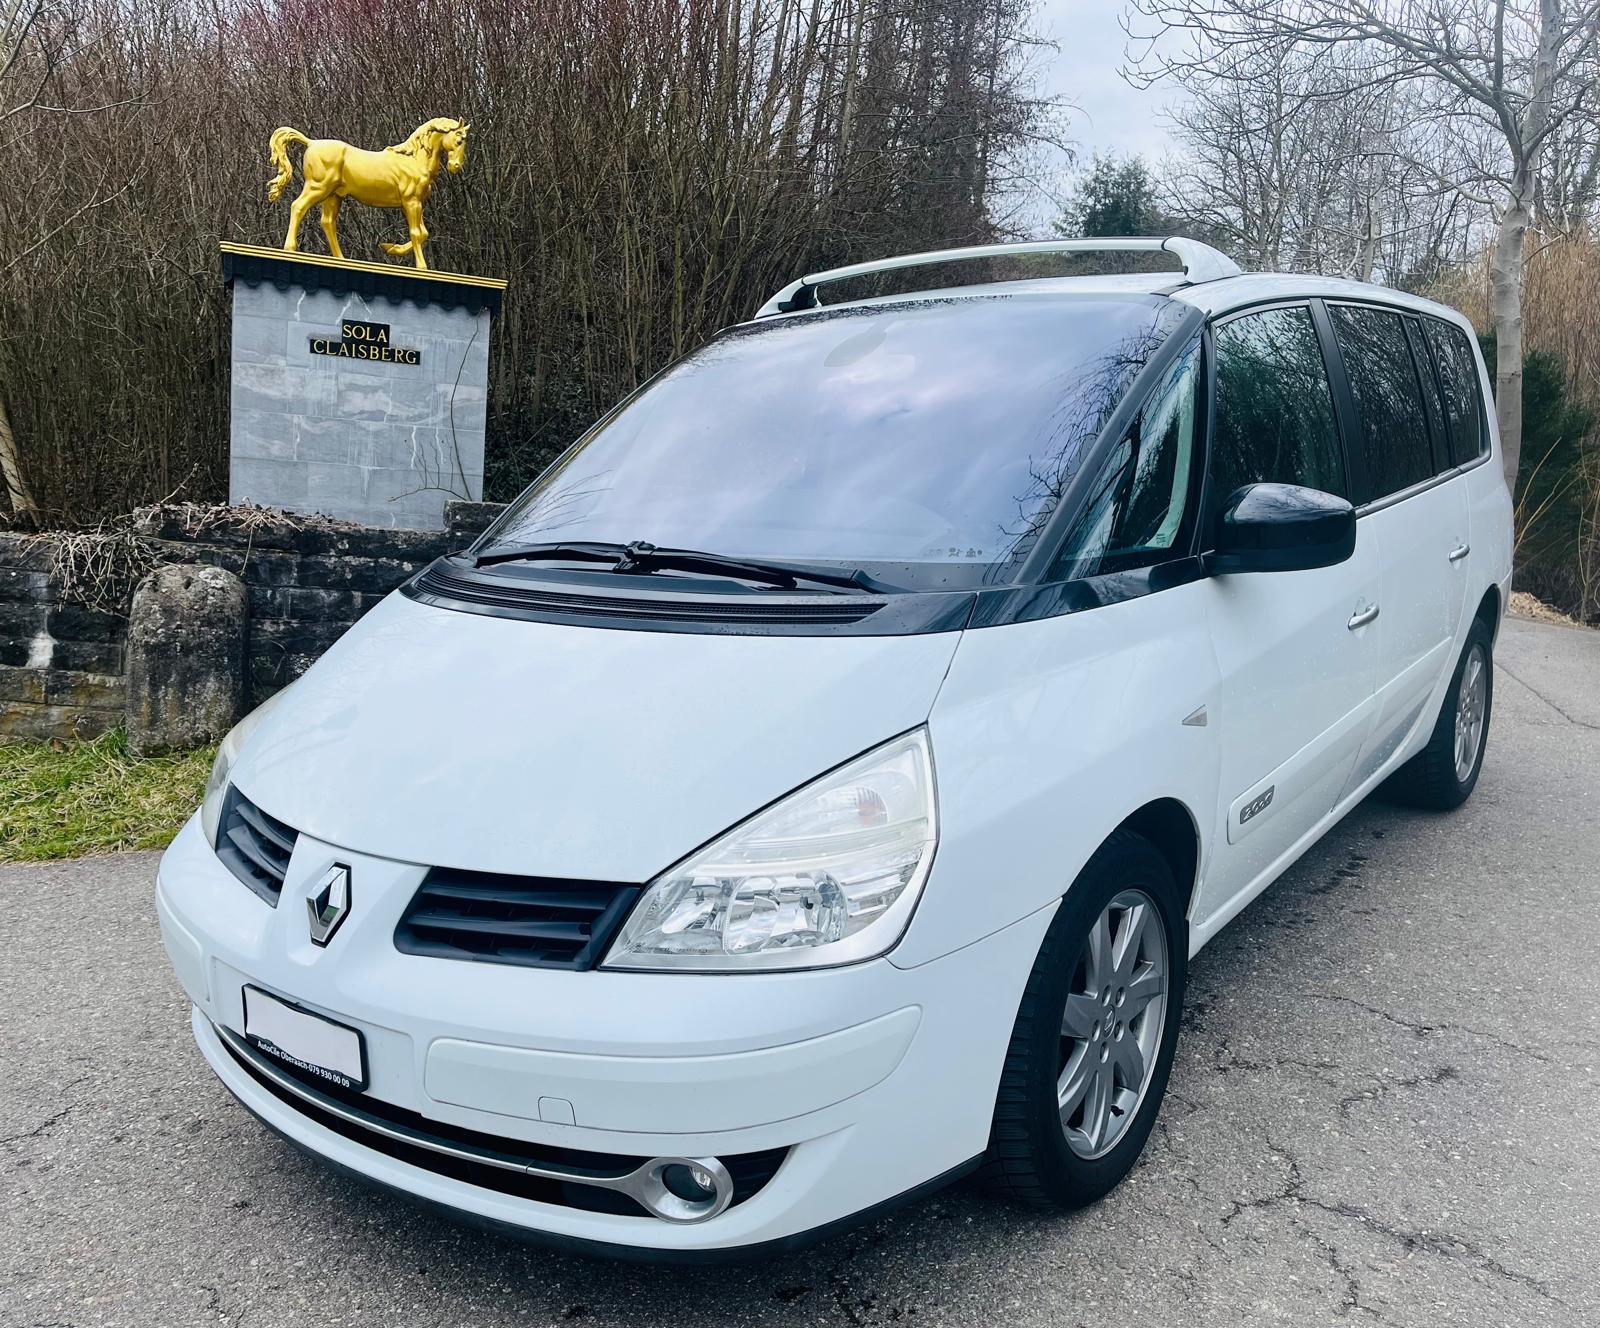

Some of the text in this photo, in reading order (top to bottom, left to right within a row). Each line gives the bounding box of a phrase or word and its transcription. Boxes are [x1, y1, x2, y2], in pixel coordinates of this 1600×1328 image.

[342, 324, 388, 343] SOLA
[313, 339, 417, 364] CLAISBERG
[320, 1069, 332, 1080] 930
[332, 1074, 341, 1084] 00
[341, 1078, 350, 1088] 09
